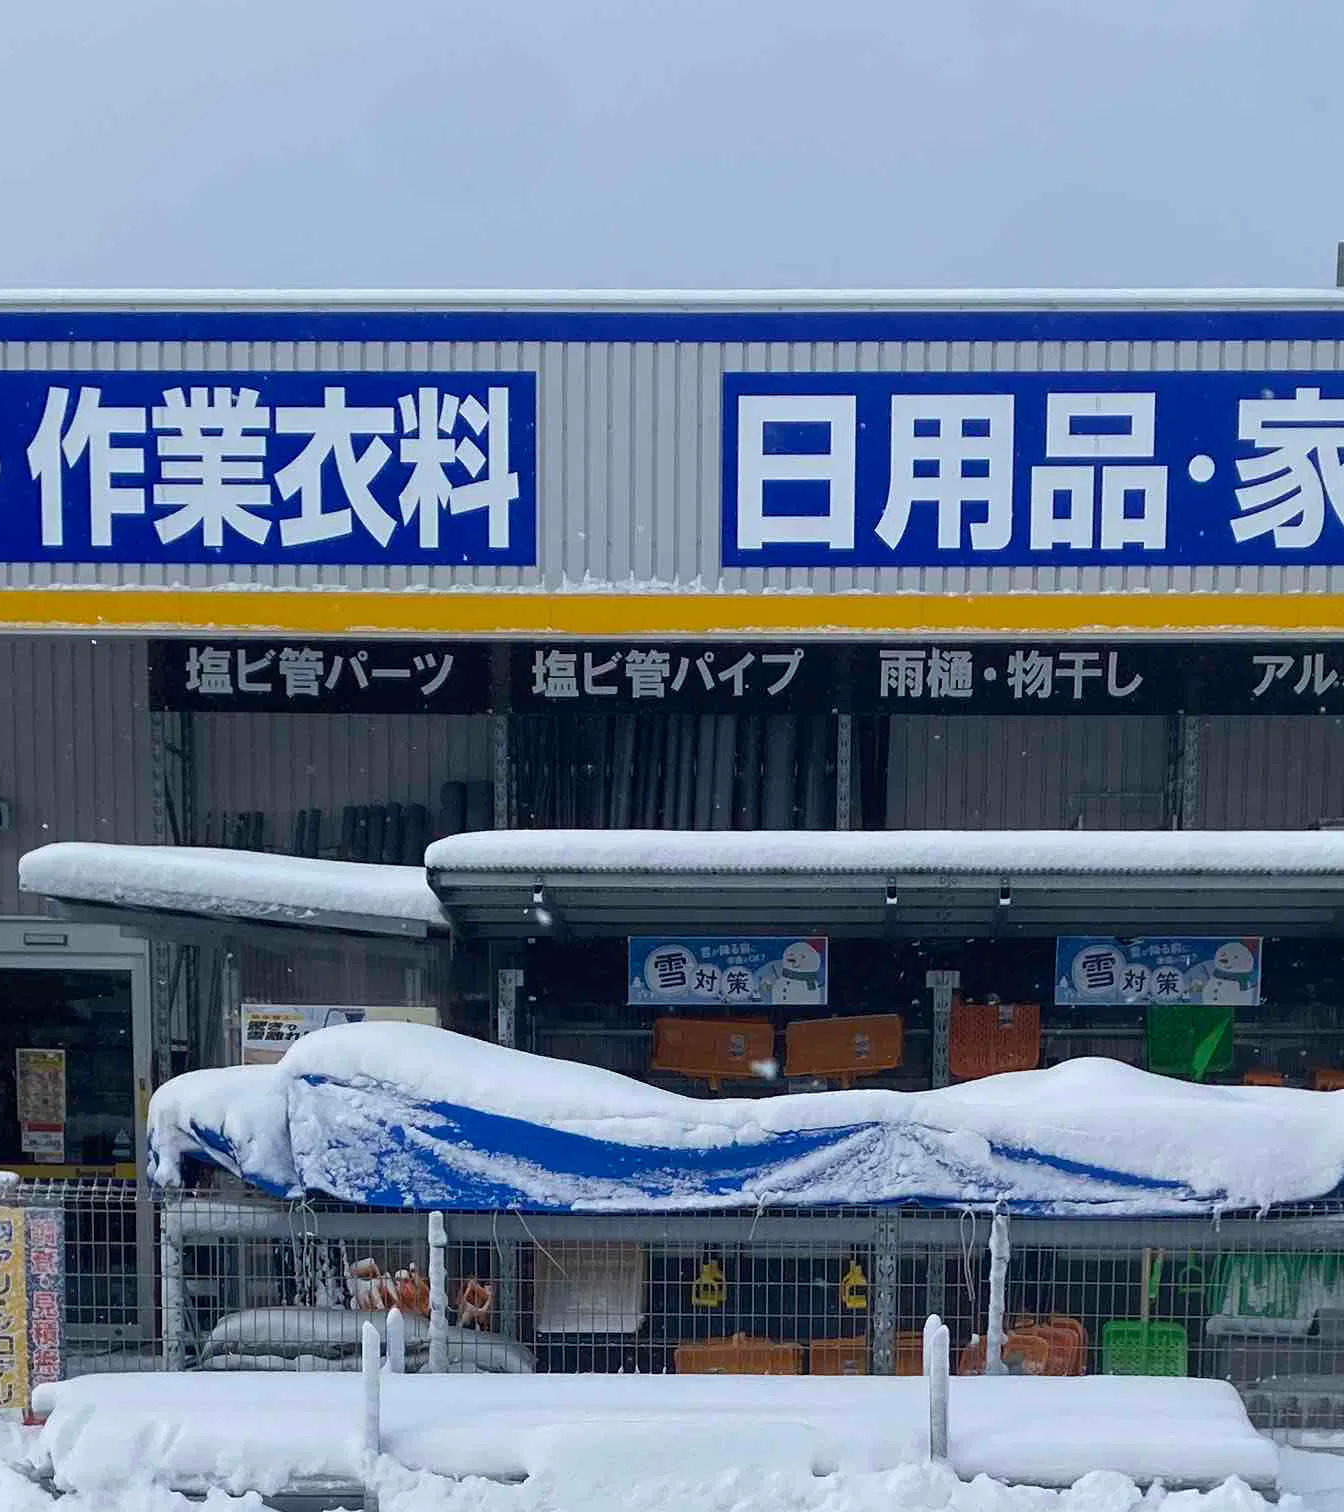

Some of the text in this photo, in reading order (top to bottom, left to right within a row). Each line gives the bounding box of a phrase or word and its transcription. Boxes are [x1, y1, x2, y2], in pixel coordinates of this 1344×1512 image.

[185, 647, 455, 698] 塩ビ管パーツ
[531, 647, 805, 698] 塩ビ管パイプ
[878, 647, 1144, 698] 雨樋・物干し
[654, 951, 752, 995] 雪対策
[1082, 951, 1180, 996] 雪対策
